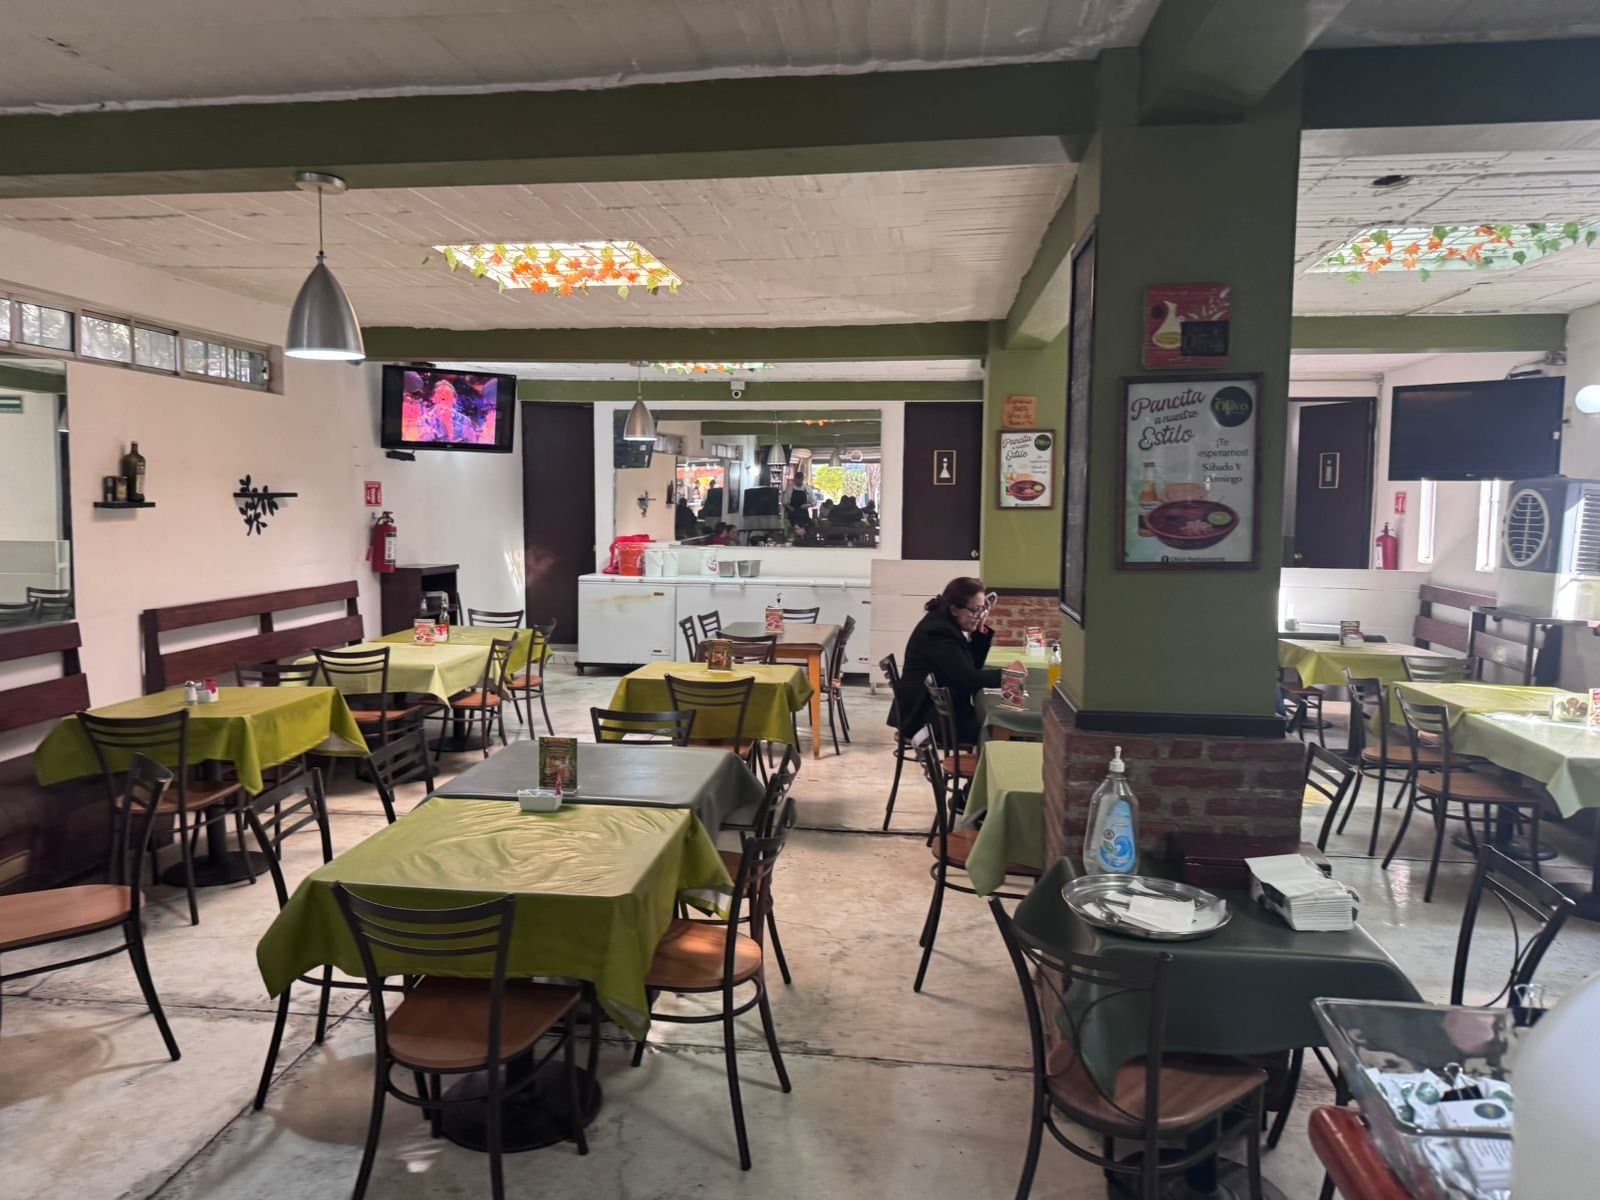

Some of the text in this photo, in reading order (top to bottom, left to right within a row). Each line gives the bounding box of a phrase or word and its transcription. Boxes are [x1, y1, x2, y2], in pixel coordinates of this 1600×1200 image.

[1131, 388, 1206, 421] Pancita
[1162, 410, 1199, 423] nuestro
[1138, 424, 1194, 450] Estilo
